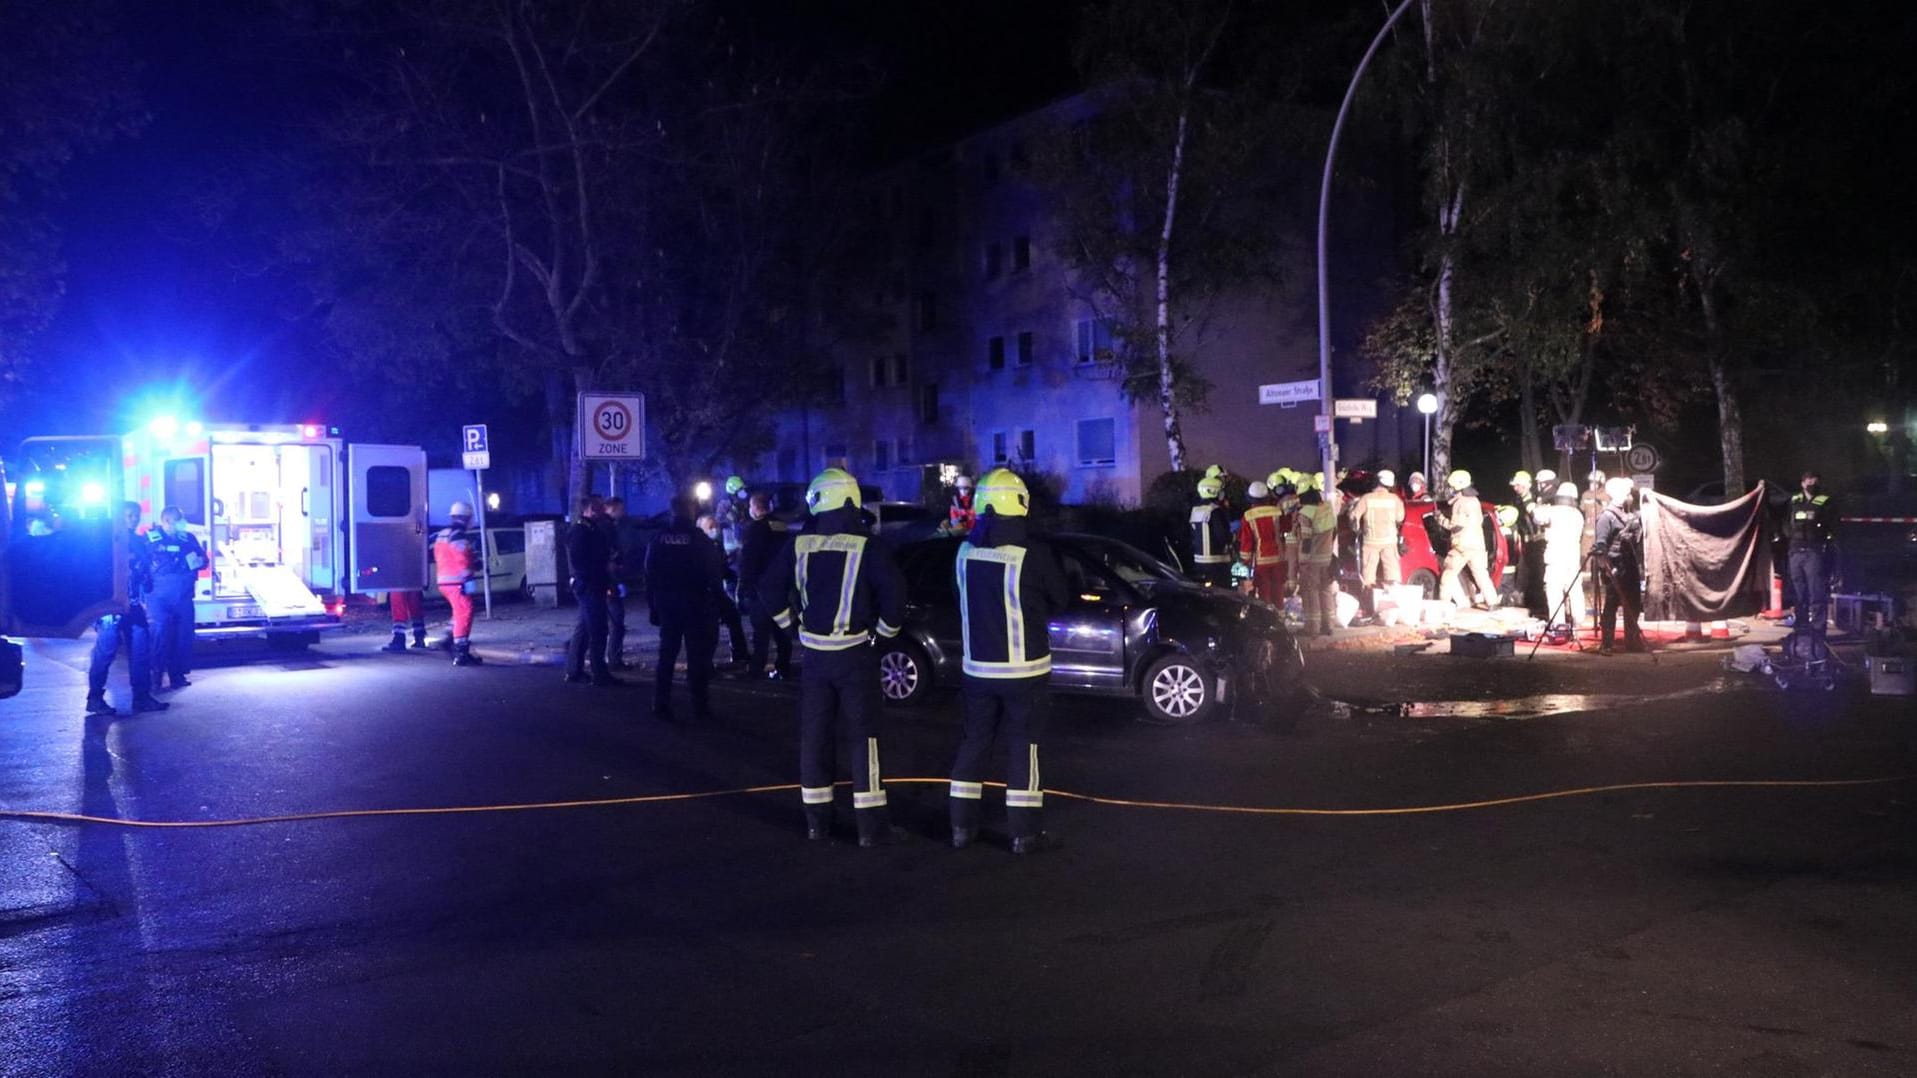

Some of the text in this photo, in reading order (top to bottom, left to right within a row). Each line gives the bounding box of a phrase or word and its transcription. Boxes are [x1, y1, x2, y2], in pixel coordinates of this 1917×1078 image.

[602, 411, 624, 430] 30
[467, 429, 480, 450] P
[599, 443, 629, 454] ZONE
